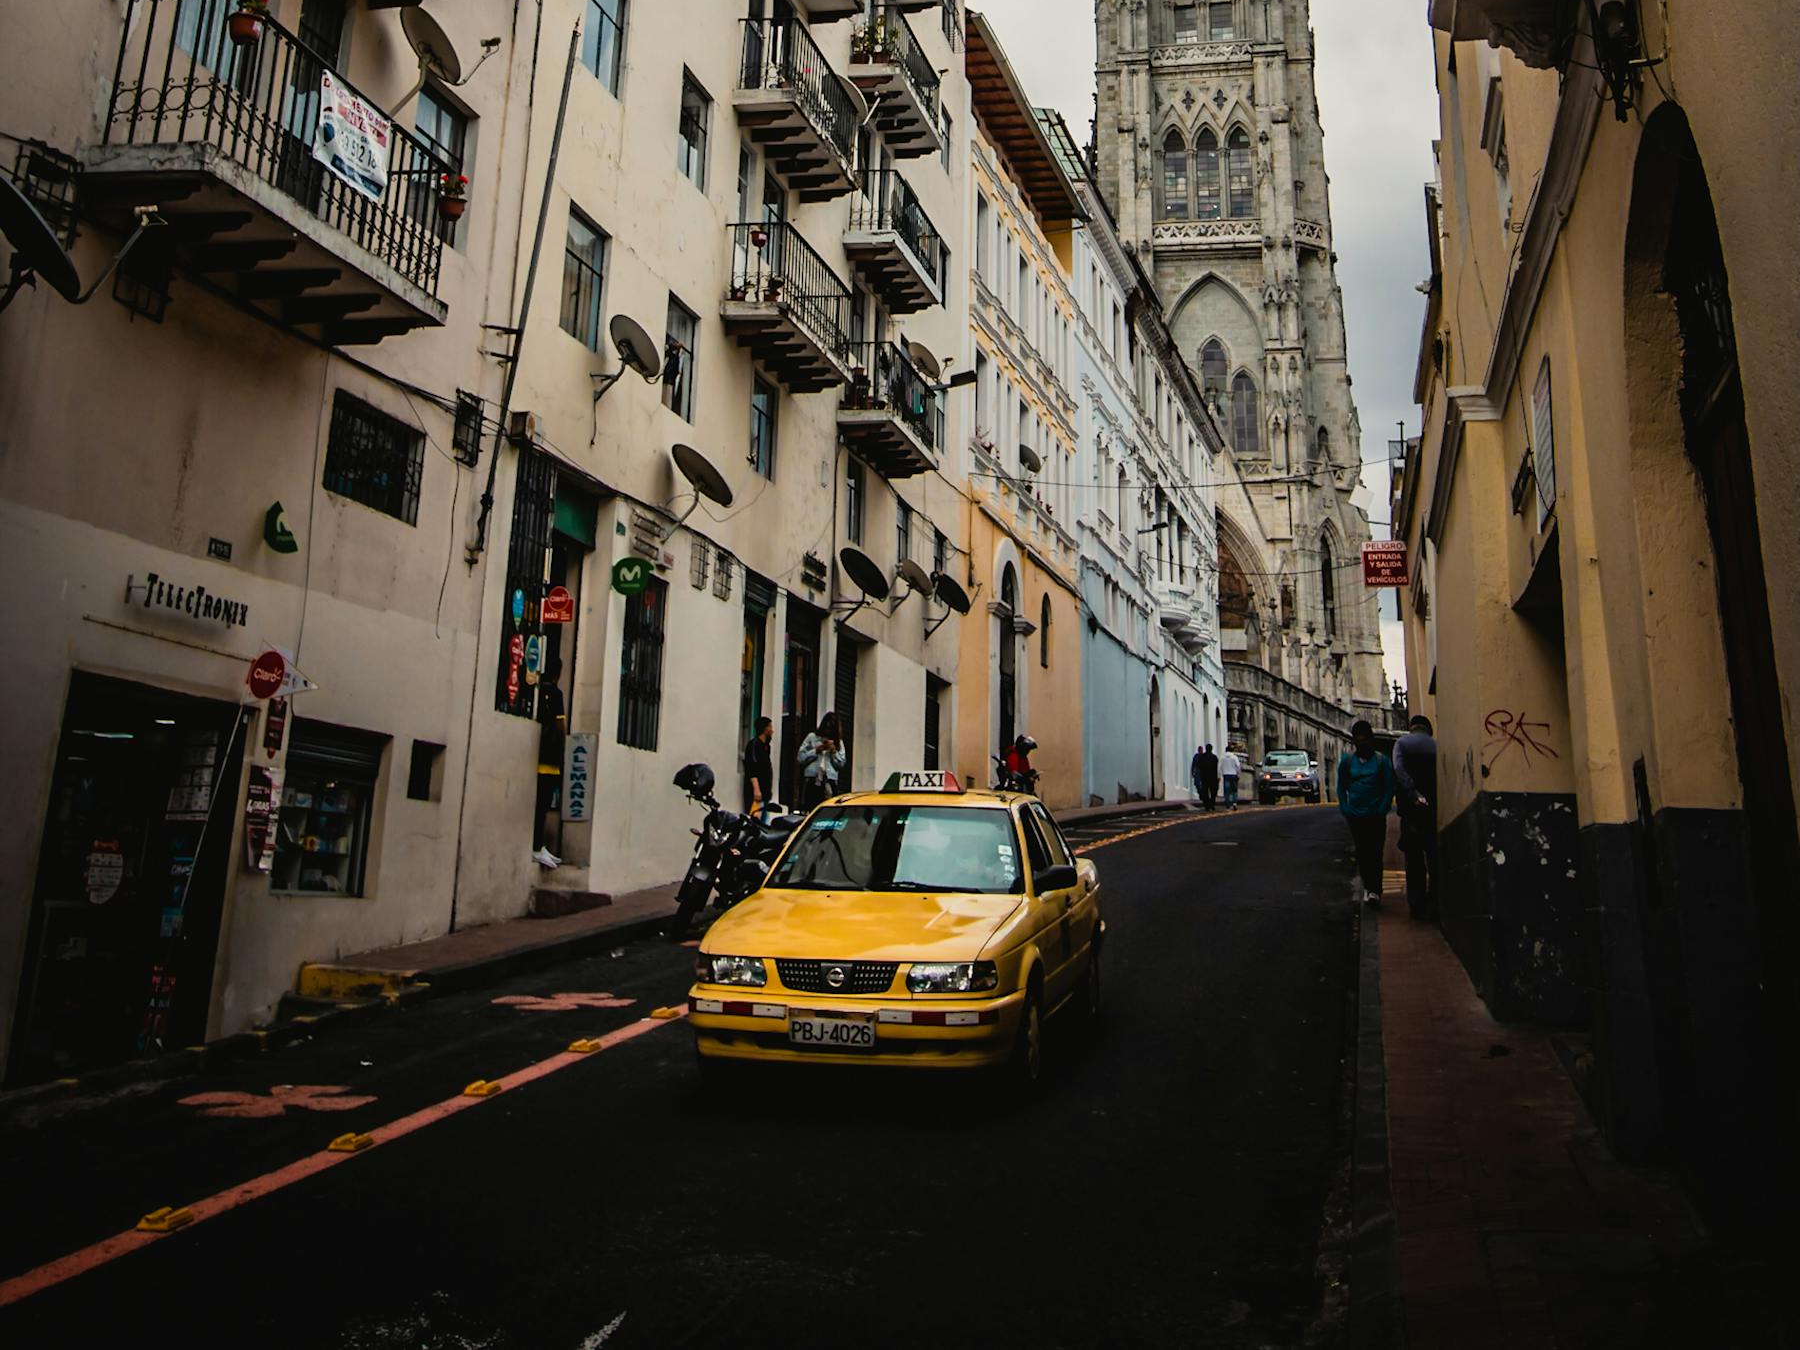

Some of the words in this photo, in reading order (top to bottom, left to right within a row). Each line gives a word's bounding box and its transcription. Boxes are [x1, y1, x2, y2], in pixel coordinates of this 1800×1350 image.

[1375, 560, 1402, 568] SALIDA
[1381, 568, 1392, 576] DE
[254, 667, 279, 682] Claro
[902, 773, 945, 788] TAXI
[791, 1020, 871, 1044] PBJ-4026
